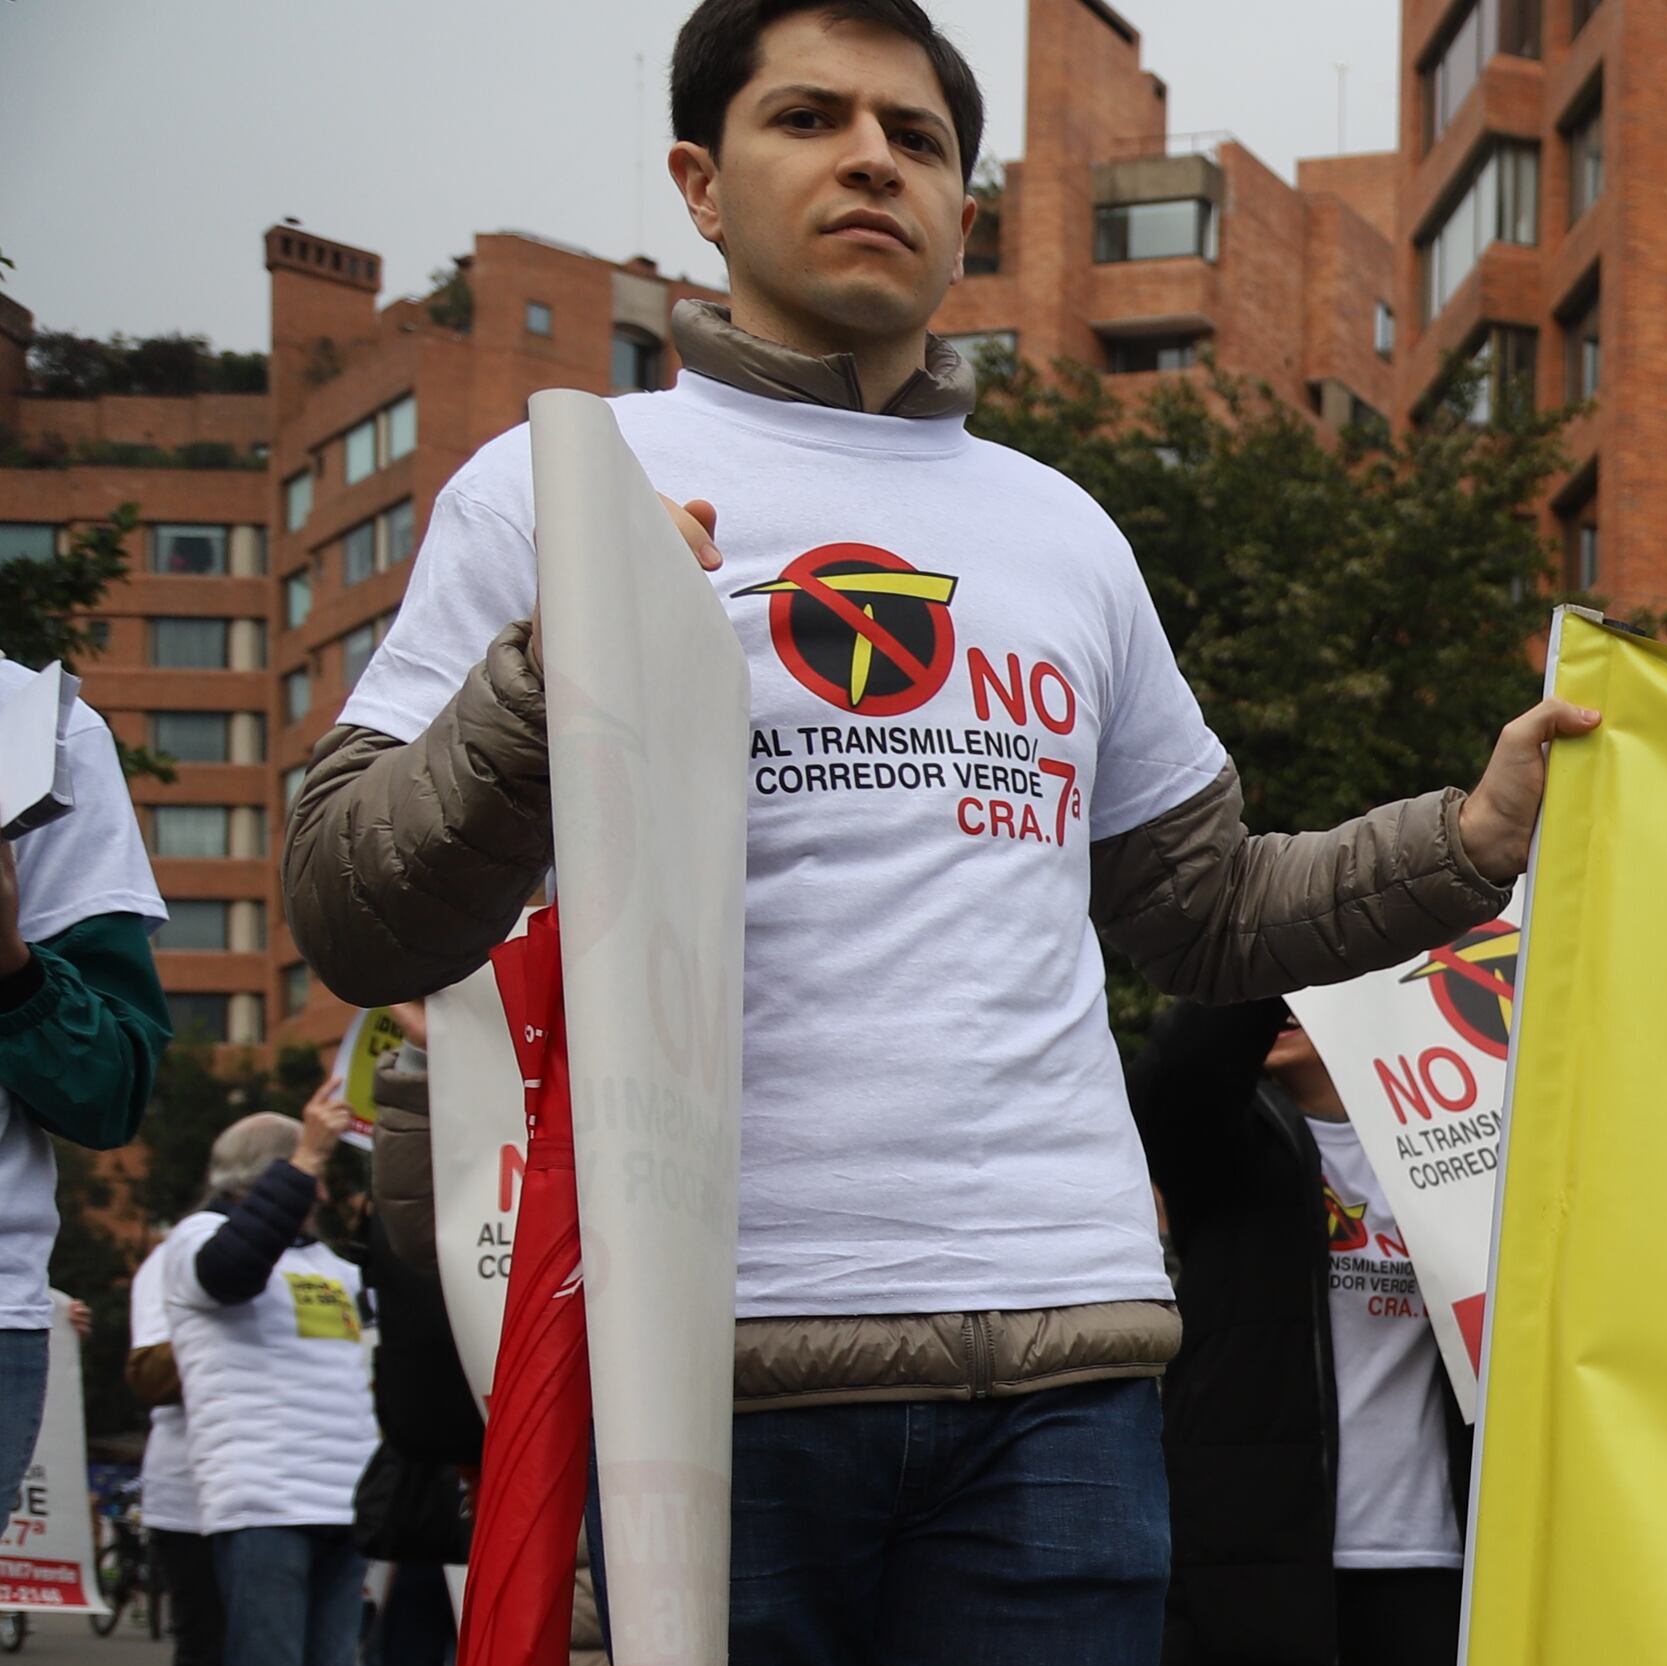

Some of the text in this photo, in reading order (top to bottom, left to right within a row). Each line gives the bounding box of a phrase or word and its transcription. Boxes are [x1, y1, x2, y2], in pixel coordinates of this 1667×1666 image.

[967, 647, 1076, 735] NO
[751, 726, 1038, 764] AL TRANSMILENIO/
[755, 762, 1043, 798] CORREDOR VERDE
[1373, 1046, 1478, 1125] NO
[1396, 1133, 1423, 1160] AL
[1409, 1144, 1499, 1190] CORRED
[1369, 1277, 1416, 1294] VERDE
